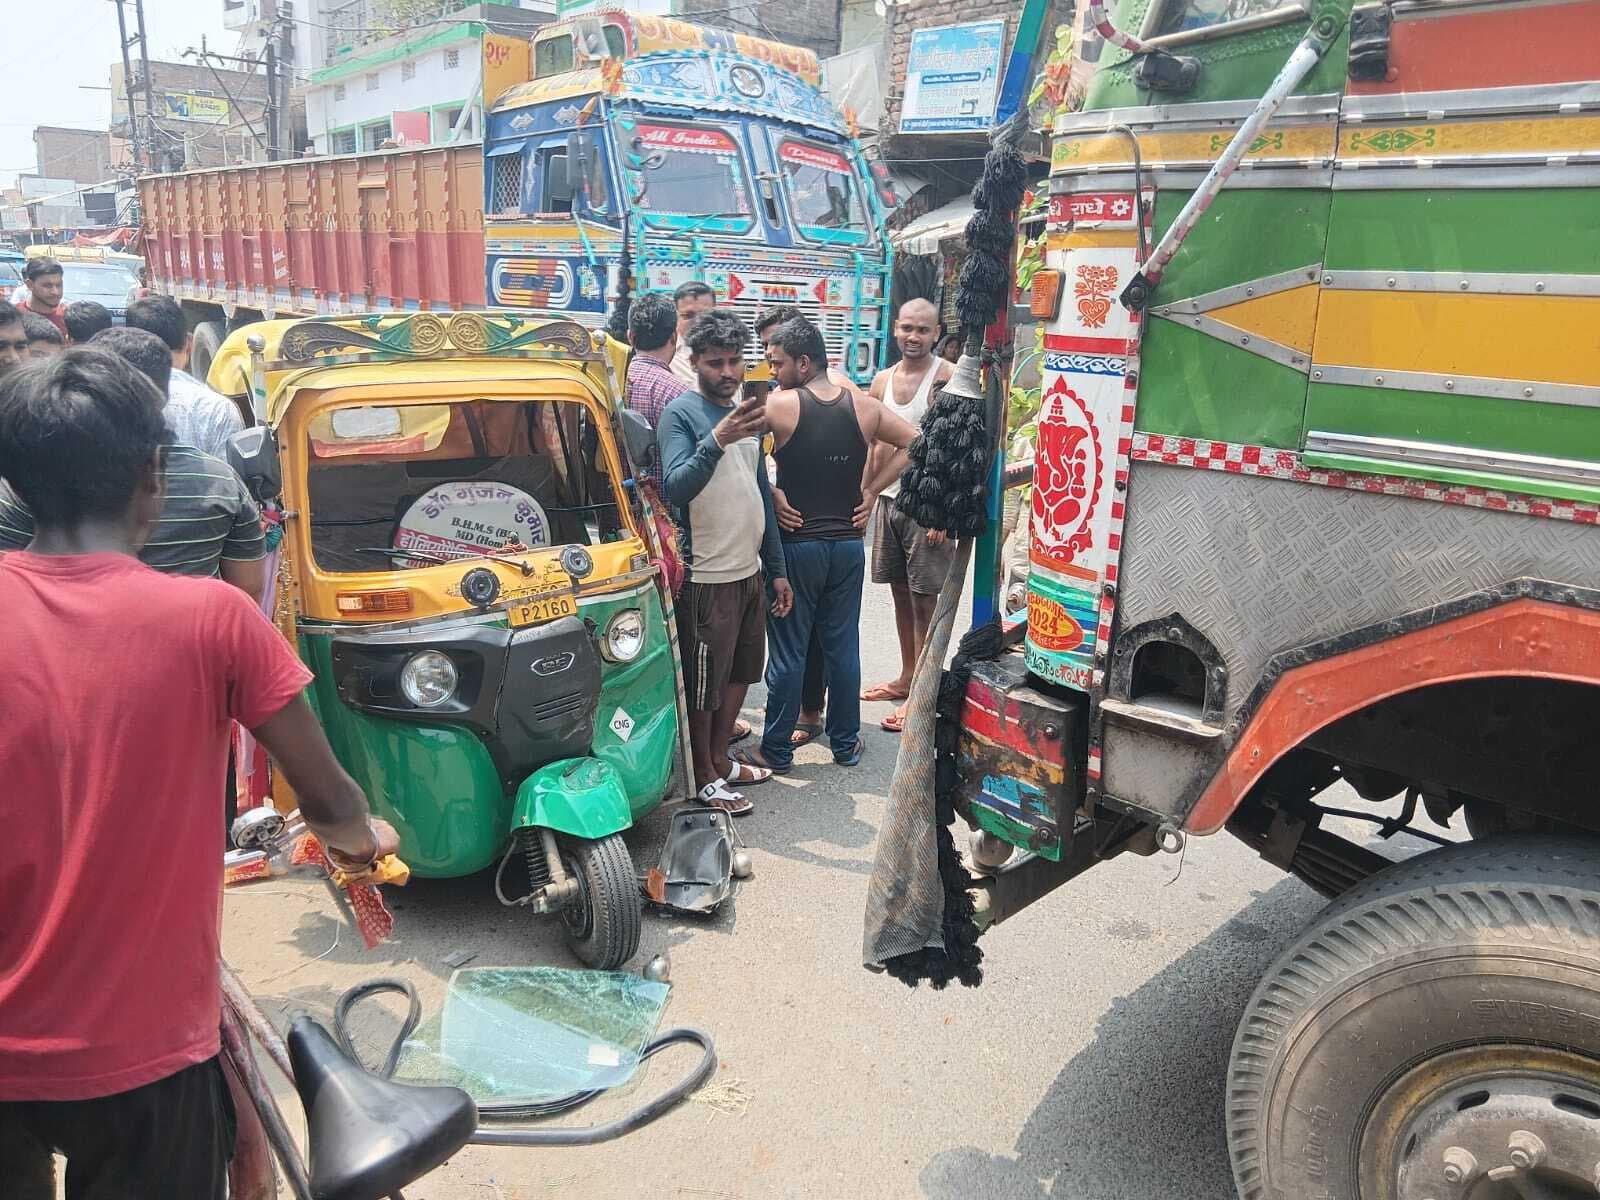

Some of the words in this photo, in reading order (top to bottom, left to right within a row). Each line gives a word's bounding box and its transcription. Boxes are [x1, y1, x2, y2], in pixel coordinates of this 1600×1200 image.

[644, 130, 670, 142] All
[672, 131, 717, 146] India
[1070, 198, 1106, 216] राधे
[761, 285, 798, 300] TATA
[451, 517, 494, 535] B.H.M.S
[514, 498, 545, 544] कुमार
[454, 529, 474, 542] MD
[521, 599, 570, 622] P2160
[613, 719, 630, 730] CNG
